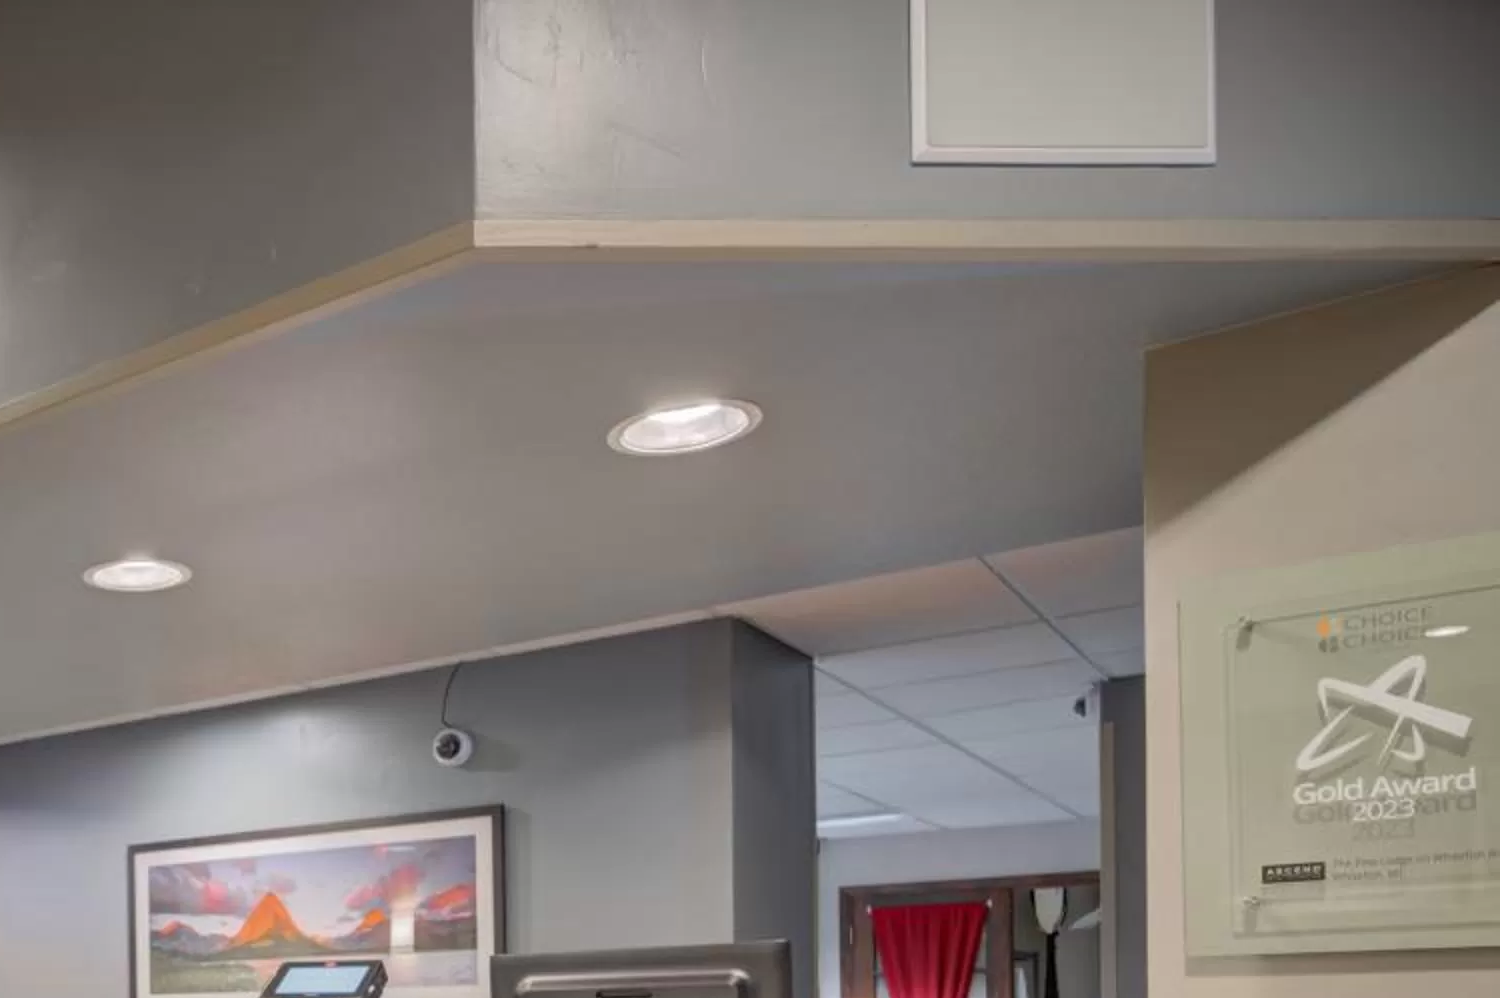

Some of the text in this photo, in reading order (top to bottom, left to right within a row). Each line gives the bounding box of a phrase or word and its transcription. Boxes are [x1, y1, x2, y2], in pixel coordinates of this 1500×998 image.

[1292, 765, 1476, 805] Gold Award
[1353, 798, 1415, 822] 2023
